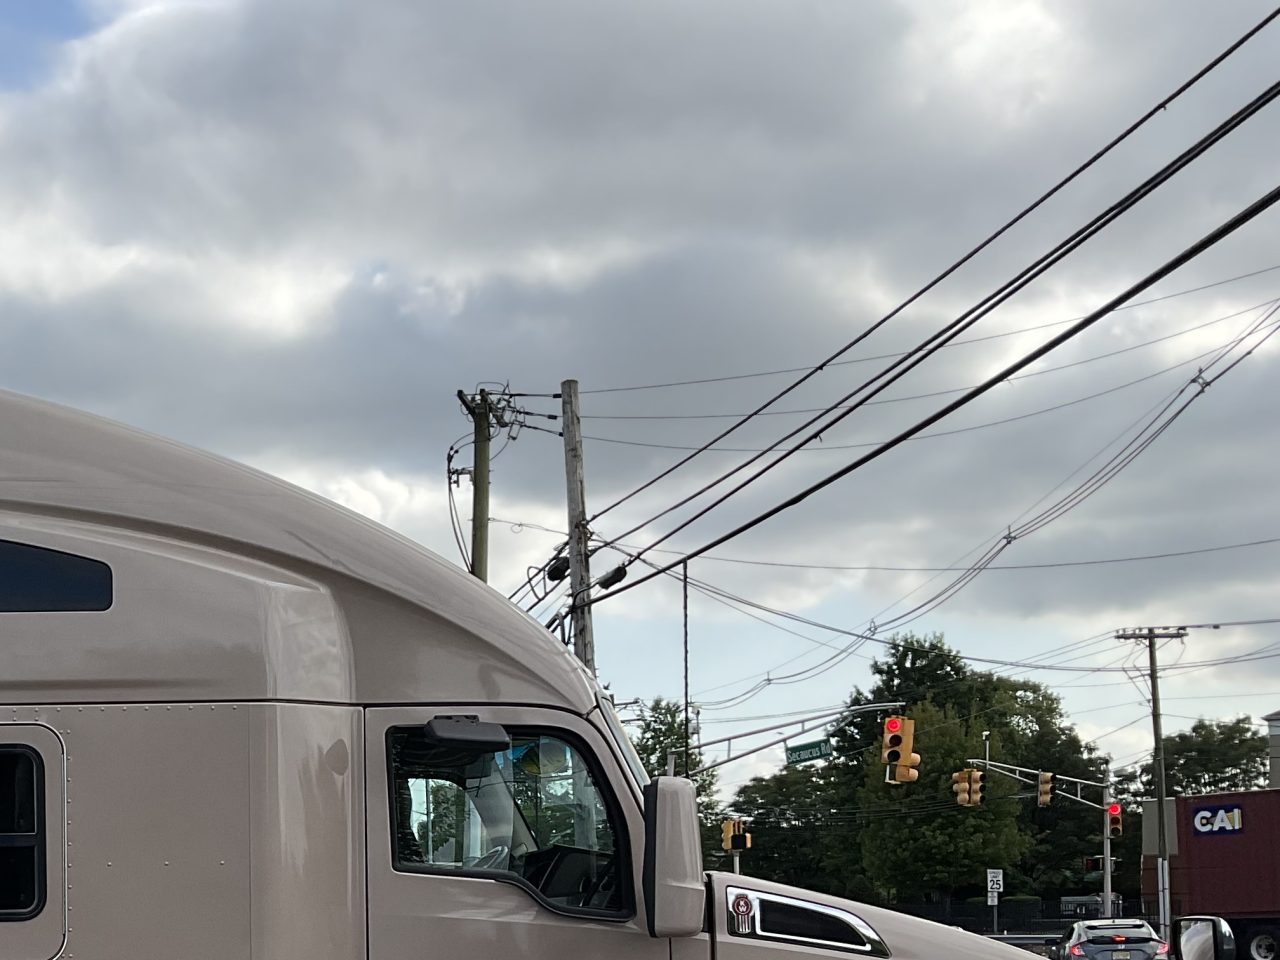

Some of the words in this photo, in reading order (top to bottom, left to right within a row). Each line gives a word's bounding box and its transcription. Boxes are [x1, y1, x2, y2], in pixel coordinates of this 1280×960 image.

[787, 748, 820, 762] Secaucus
[821, 742, 831, 755] Rd
[1194, 808, 1239, 832] CAI
[990, 879, 1001, 890] 25
